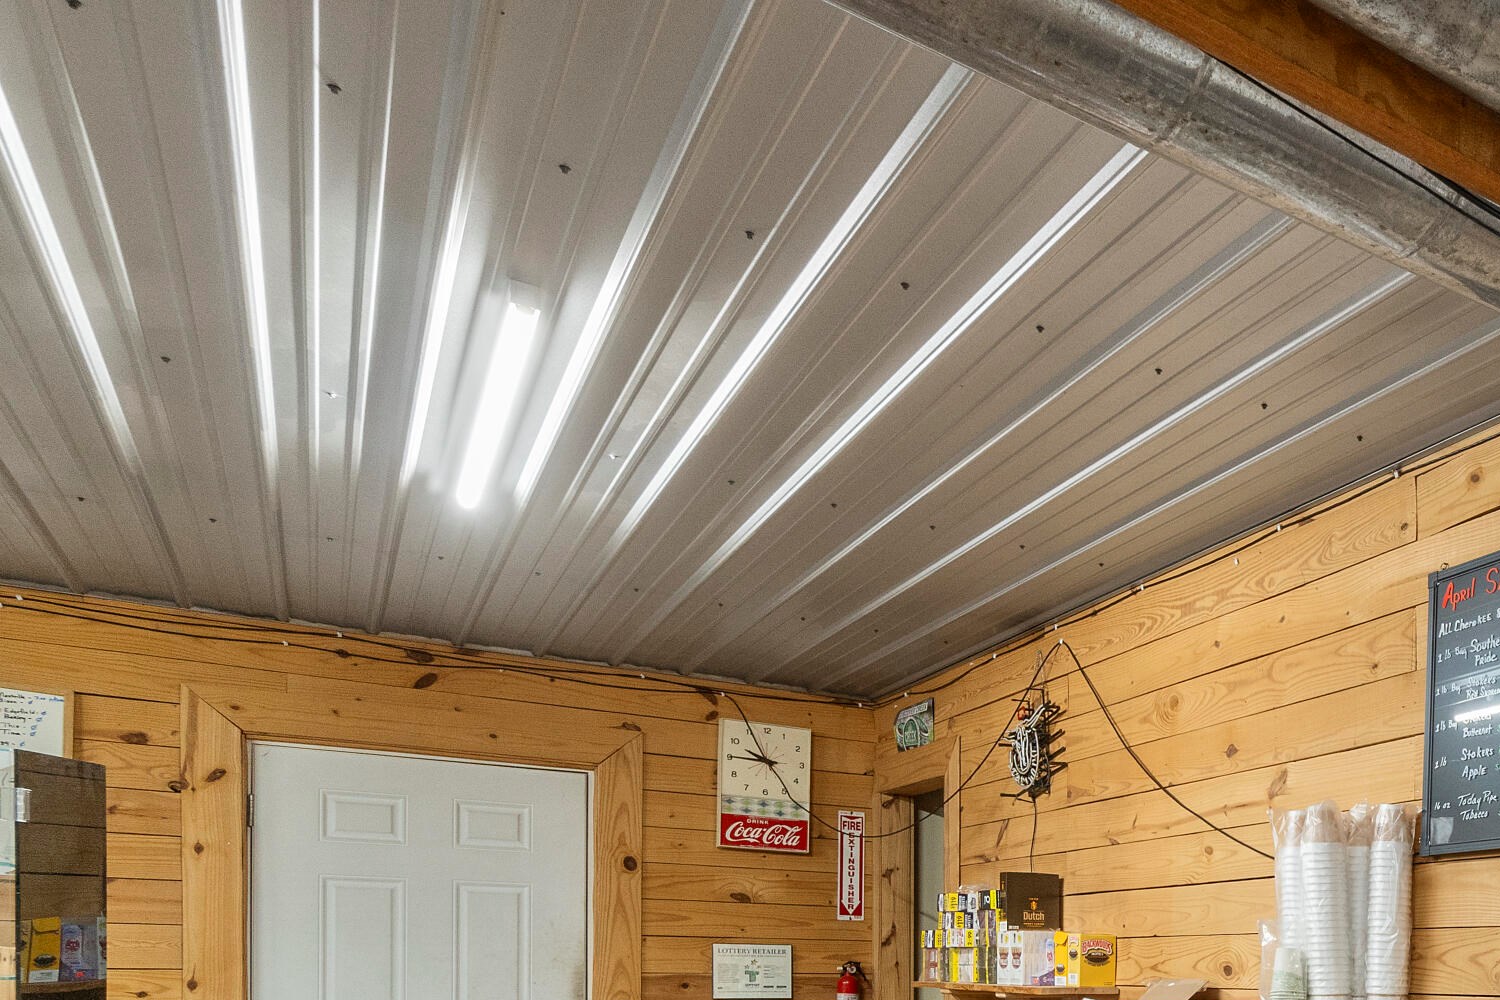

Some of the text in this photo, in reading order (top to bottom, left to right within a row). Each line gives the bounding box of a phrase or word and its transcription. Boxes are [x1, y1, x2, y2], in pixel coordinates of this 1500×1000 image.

[725, 821, 803, 846] Coca-Cola
[842, 821, 861, 831] FIRE
[847, 832, 855, 910] EXTINGUISHER
[1023, 911, 1045, 921] Dutch
